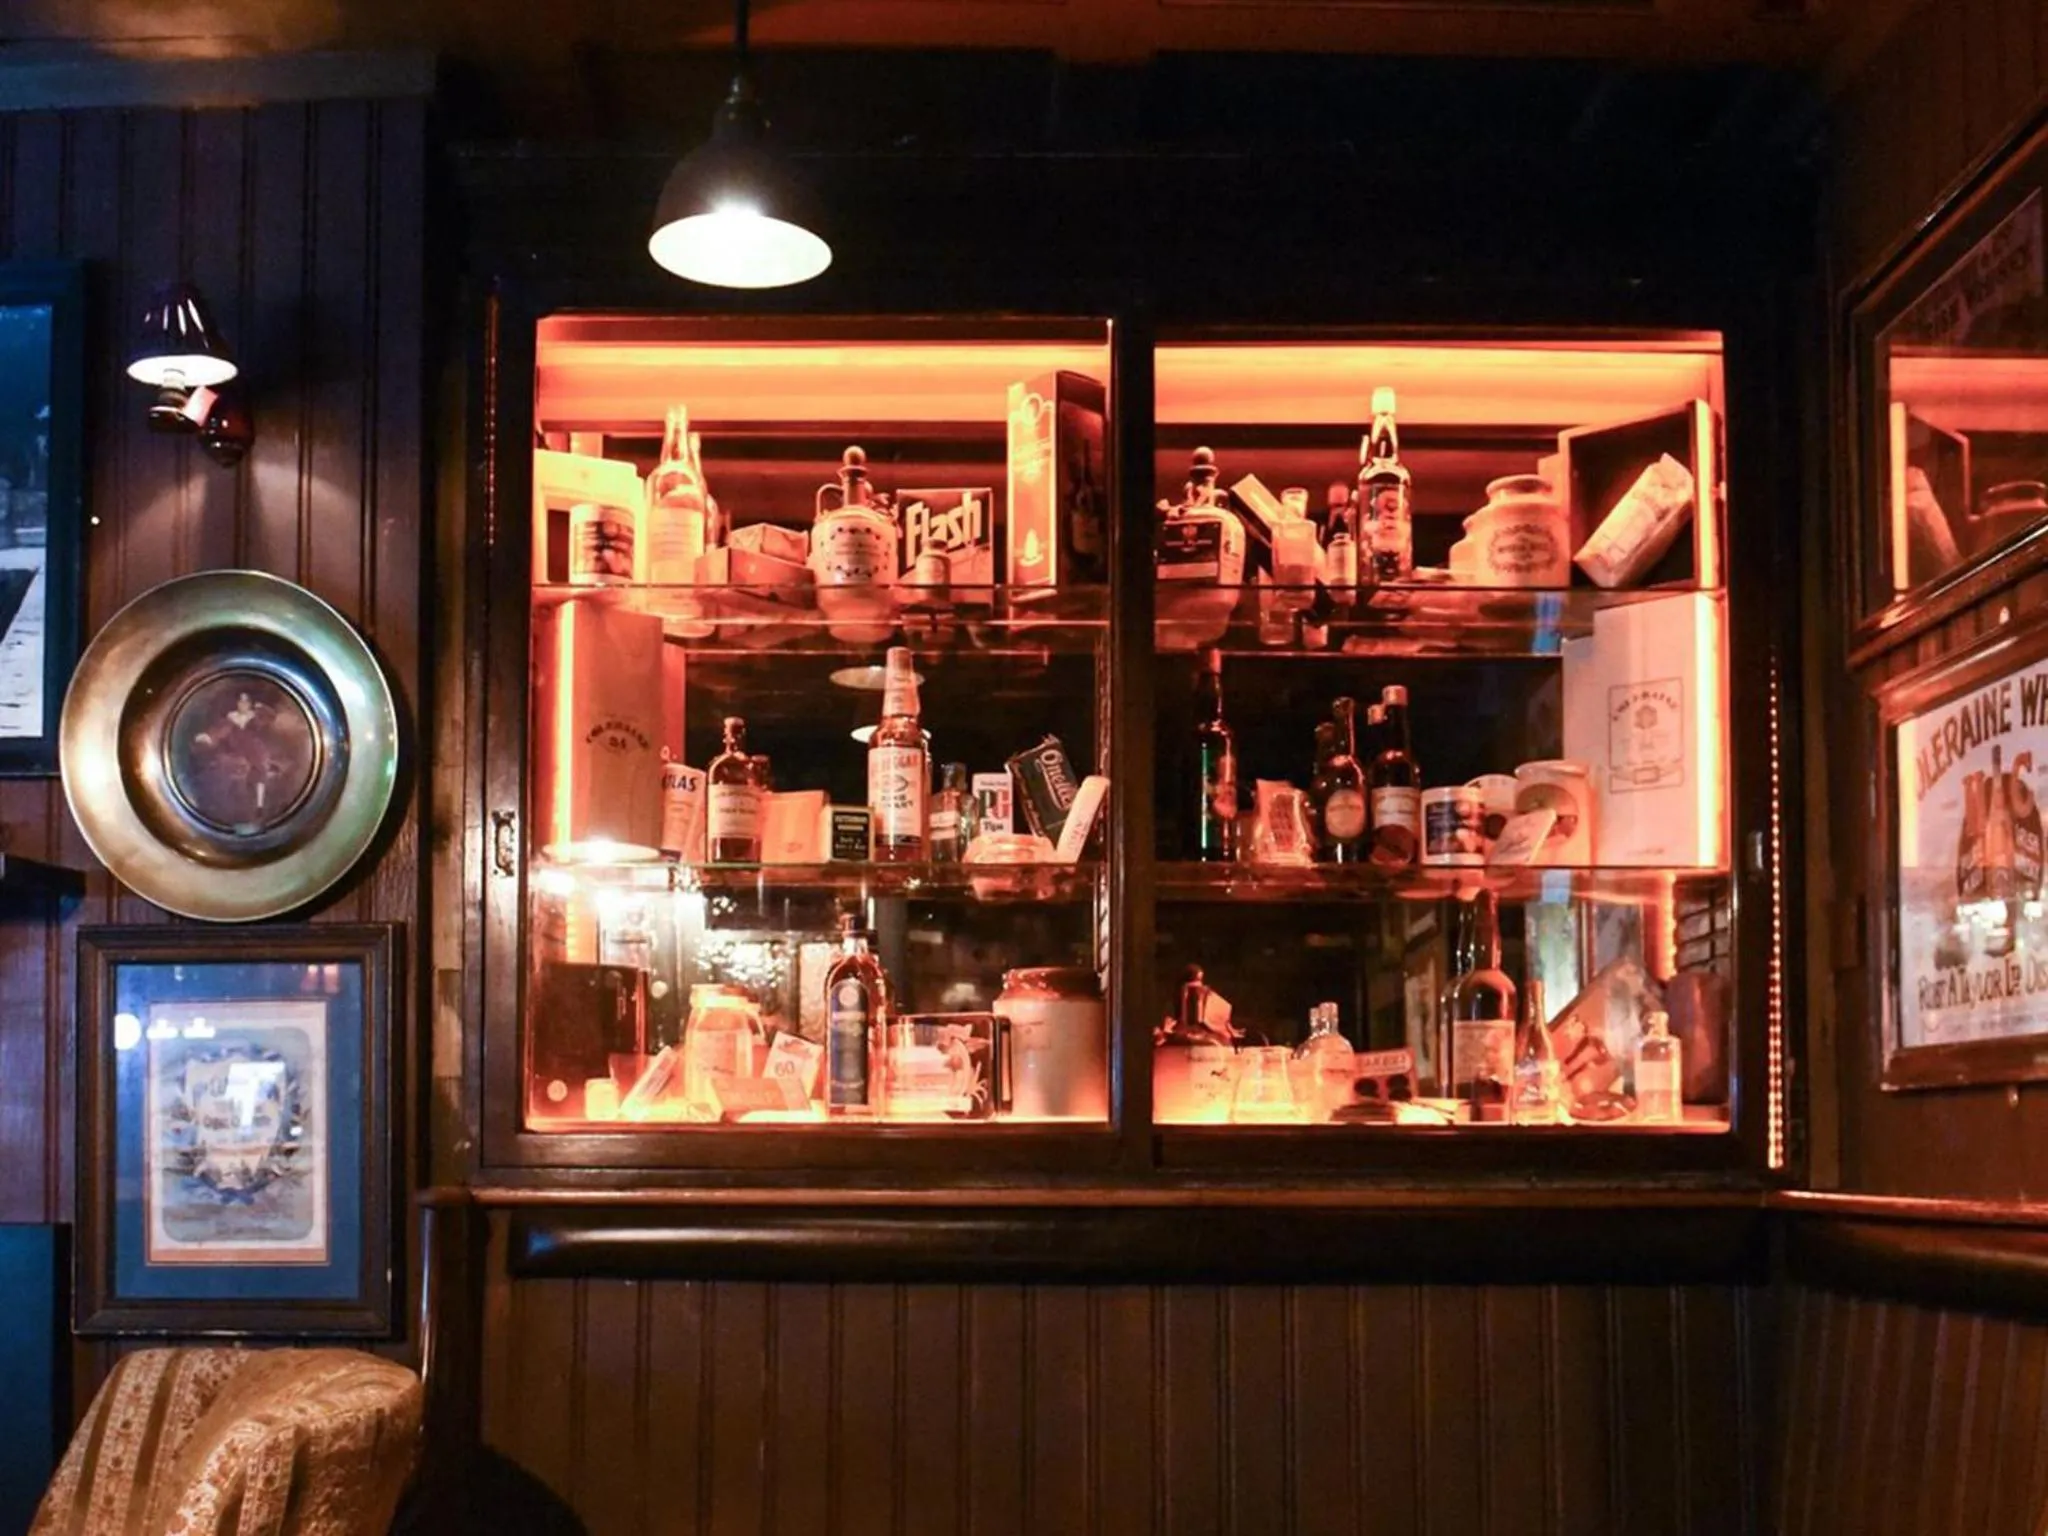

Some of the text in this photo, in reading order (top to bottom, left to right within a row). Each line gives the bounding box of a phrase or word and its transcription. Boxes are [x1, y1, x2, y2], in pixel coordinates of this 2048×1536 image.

[906, 488, 982, 568] Flash
[979, 789, 1010, 819] PG
[983, 821, 1005, 833] Tips
